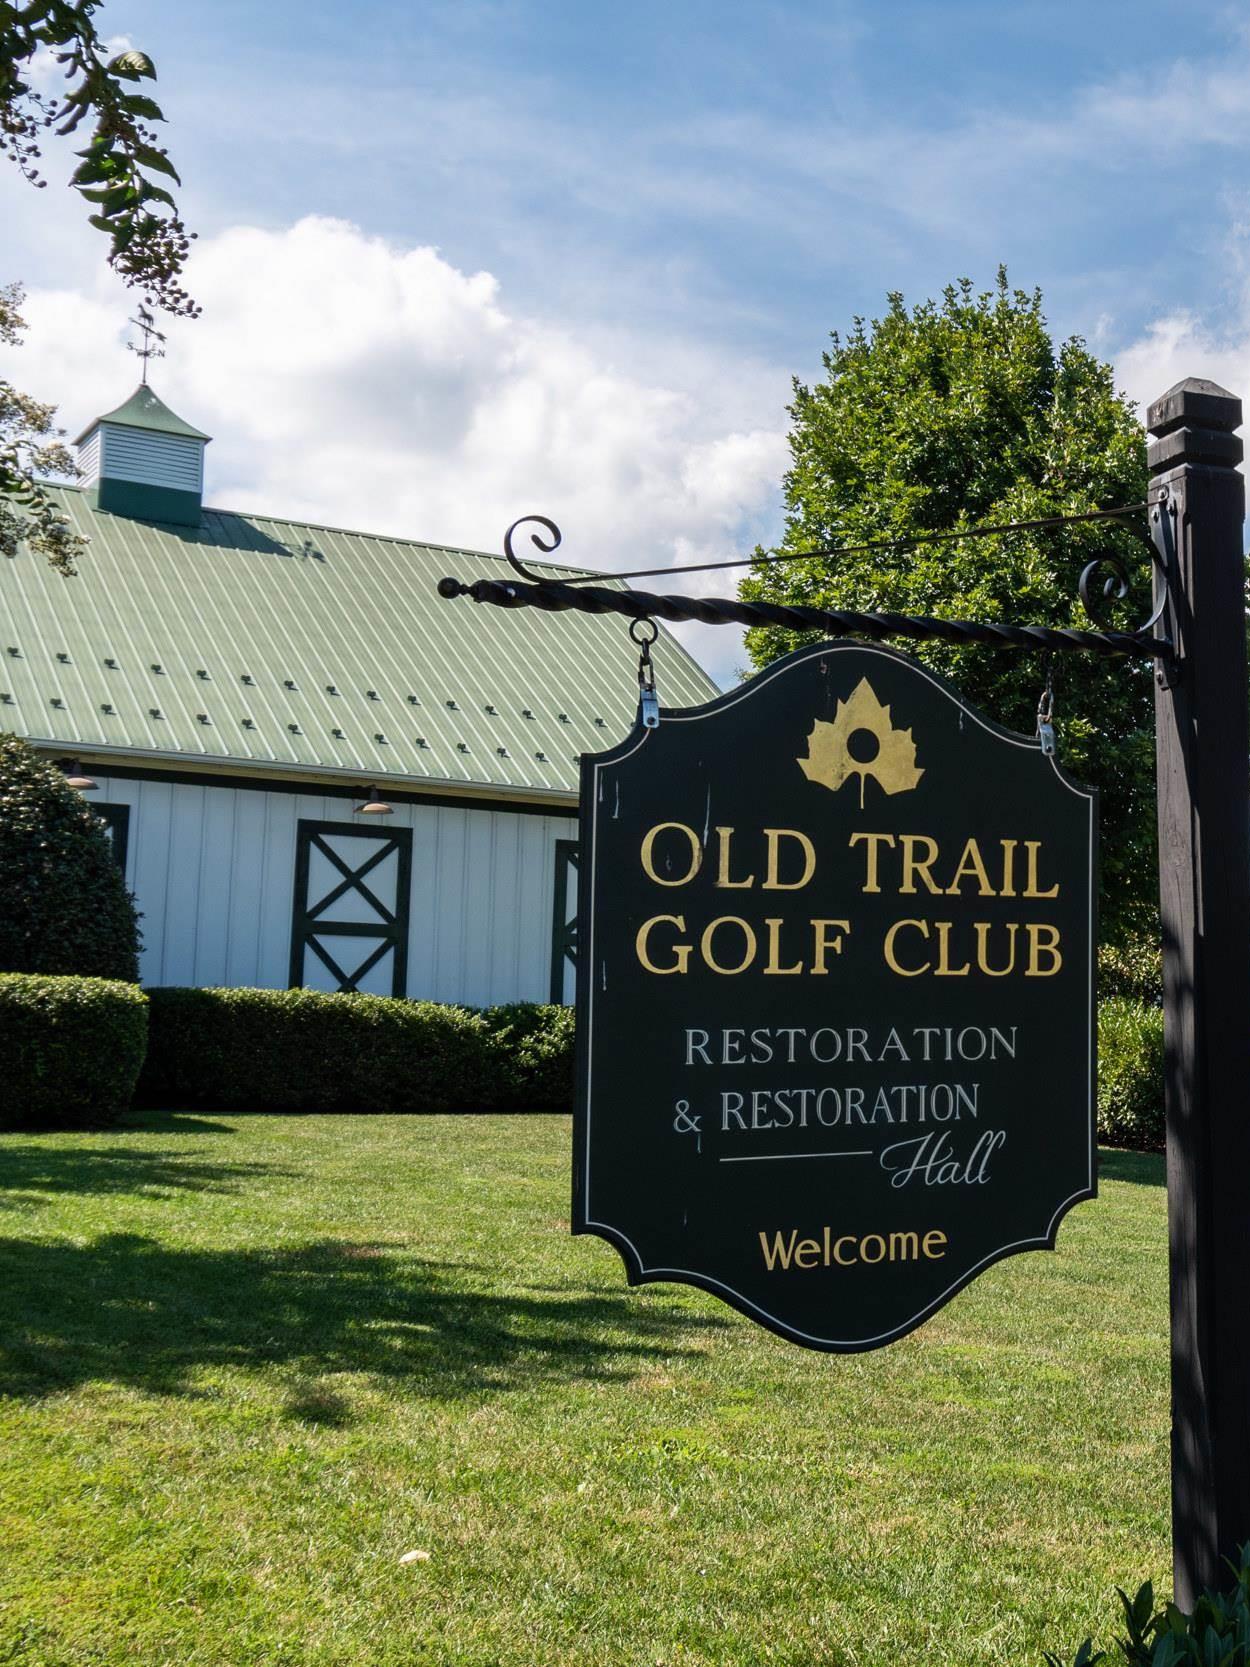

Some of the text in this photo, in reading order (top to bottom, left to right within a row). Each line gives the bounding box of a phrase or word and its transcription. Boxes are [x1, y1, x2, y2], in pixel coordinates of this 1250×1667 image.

[641, 822, 1059, 897] OLD TRAIL
[636, 915, 1062, 976] GOLF CLUB
[685, 1026, 1017, 1065] RESTORATION
[674, 1084, 979, 1133] & RESTORATION
[880, 1130, 1006, 1188] Hall
[759, 1227, 948, 1271] Welcome
